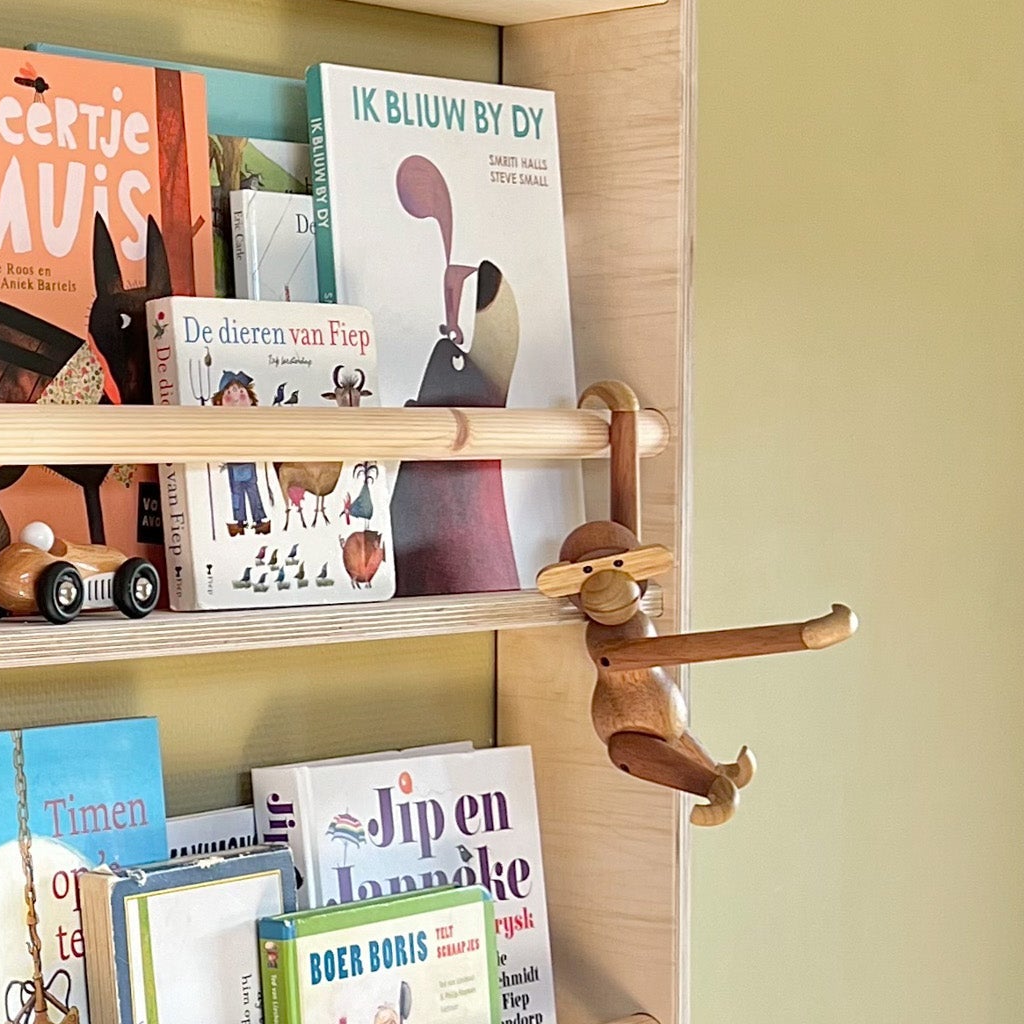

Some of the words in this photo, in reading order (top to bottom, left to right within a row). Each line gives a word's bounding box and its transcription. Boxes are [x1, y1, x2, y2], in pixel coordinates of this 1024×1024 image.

[310, 117, 323, 134] IK
[353, 86, 380, 123] IK
[385, 89, 466, 132] BLIUW
[474, 100, 503, 135] BY
[512, 104, 543, 140] DY
[312, 135, 327, 182] BLIUW
[489, 154, 518, 168] SMRITI
[521, 157, 547, 170] HALLS
[490, 171, 517, 184] STEVE
[519, 174, 549, 187] SMALL
[315, 186, 328, 203] BY
[317, 208, 330, 228] DY
[235, 234, 245, 261] Carle
[7, 263, 34, 276] Roos
[38, 266, 52, 277] en
[0, 277, 34, 290] Aniek
[37, 279, 77, 292] Bartels
[183, 316, 213, 344] De
[218, 317, 286, 346] dieren
[289, 328, 325, 346] van
[328, 320, 370, 356] Fiep
[157, 345, 171, 373] De
[167, 472, 179, 506] van
[169, 512, 185, 556] Fiep
[44, 794, 149, 838] Timen
[368, 776, 445, 860] Jip
[455, 790, 514, 836] en
[435, 925, 454, 940] TELT
[494, 907, 535, 940] rysk
[309, 943, 364, 986] BOER
[368, 930, 429, 973] BORIS
[241, 974, 253, 1006] him
[498, 965, 540, 990] hmidt
[502, 992, 530, 1010] Fiep
